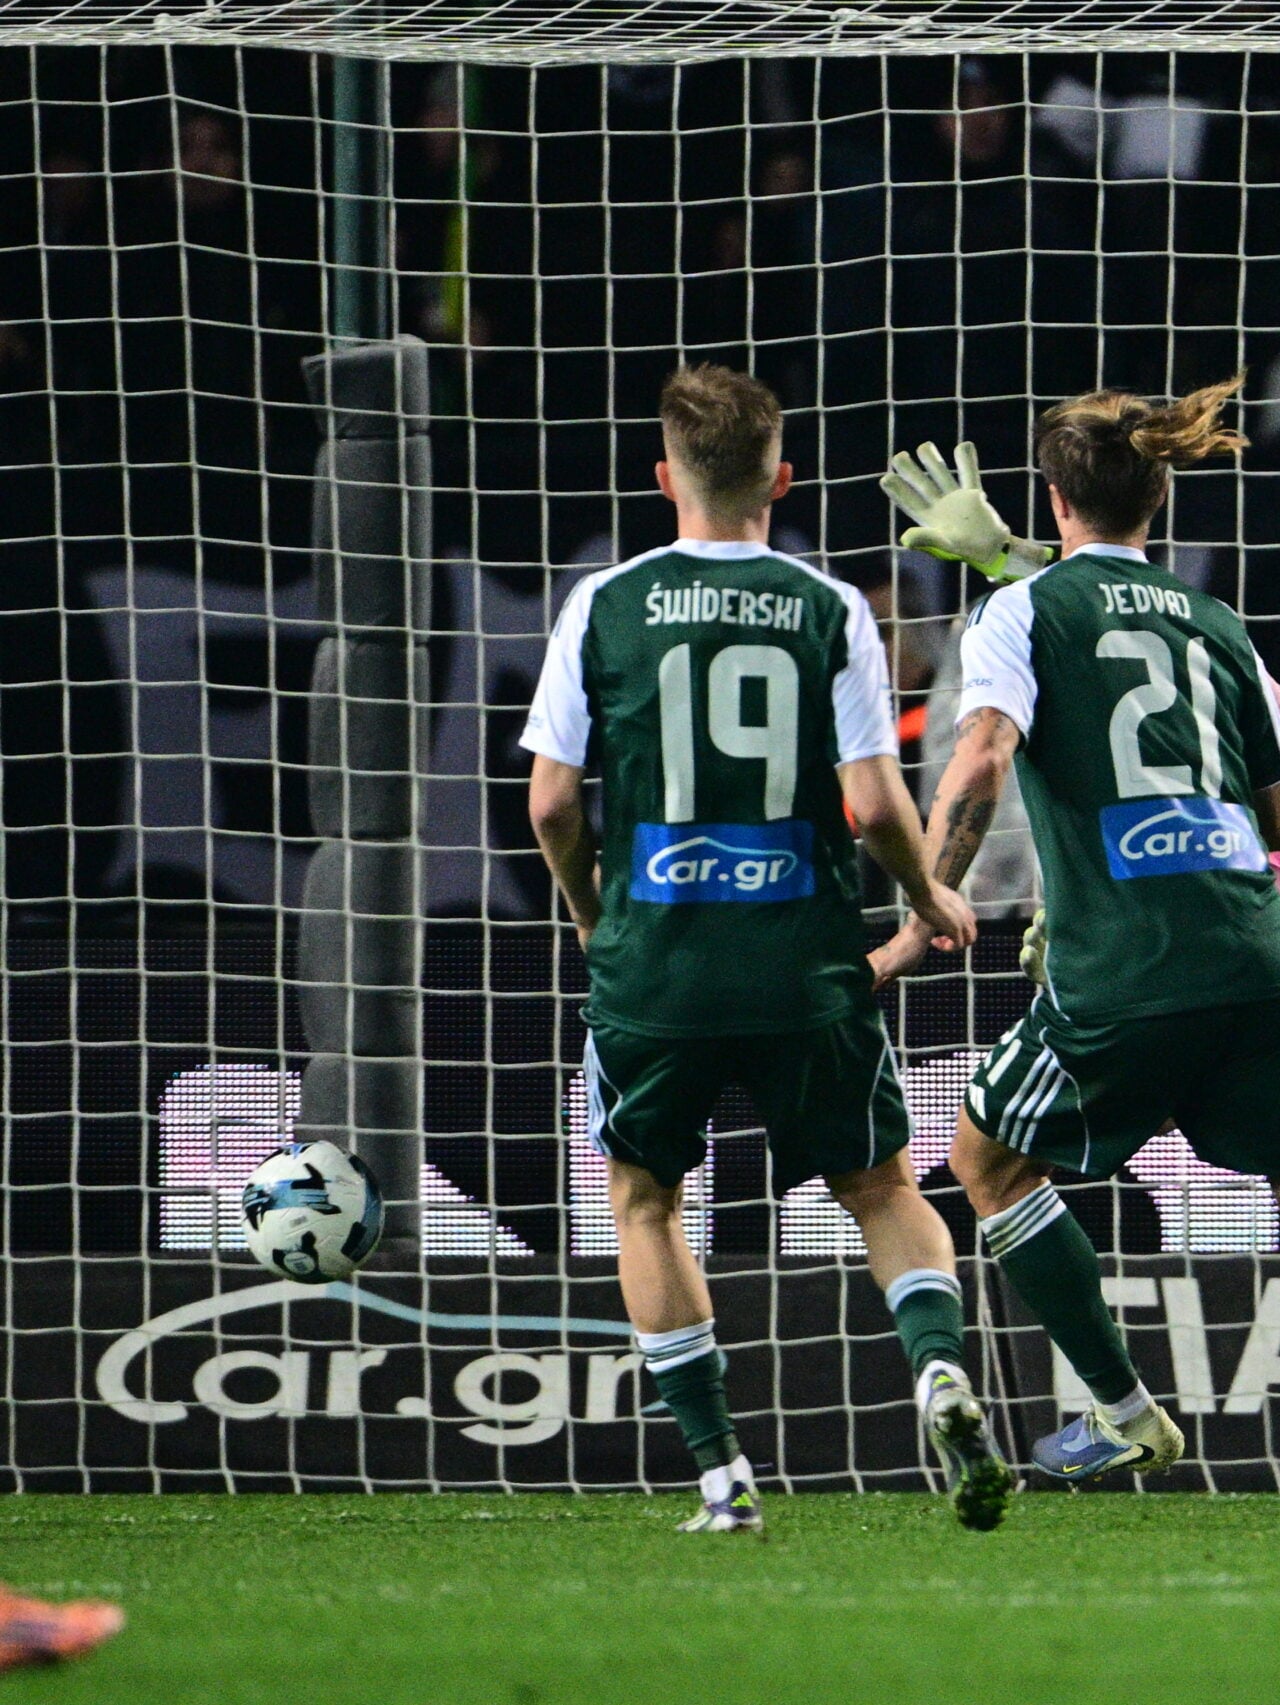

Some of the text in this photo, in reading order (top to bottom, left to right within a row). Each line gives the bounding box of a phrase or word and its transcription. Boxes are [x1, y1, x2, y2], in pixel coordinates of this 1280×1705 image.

[1098, 583, 1192, 619] JEDVAJ
[659, 642, 798, 823] 19
[1096, 630, 1223, 799] 21
[96, 1280, 648, 1446] Car.gr
